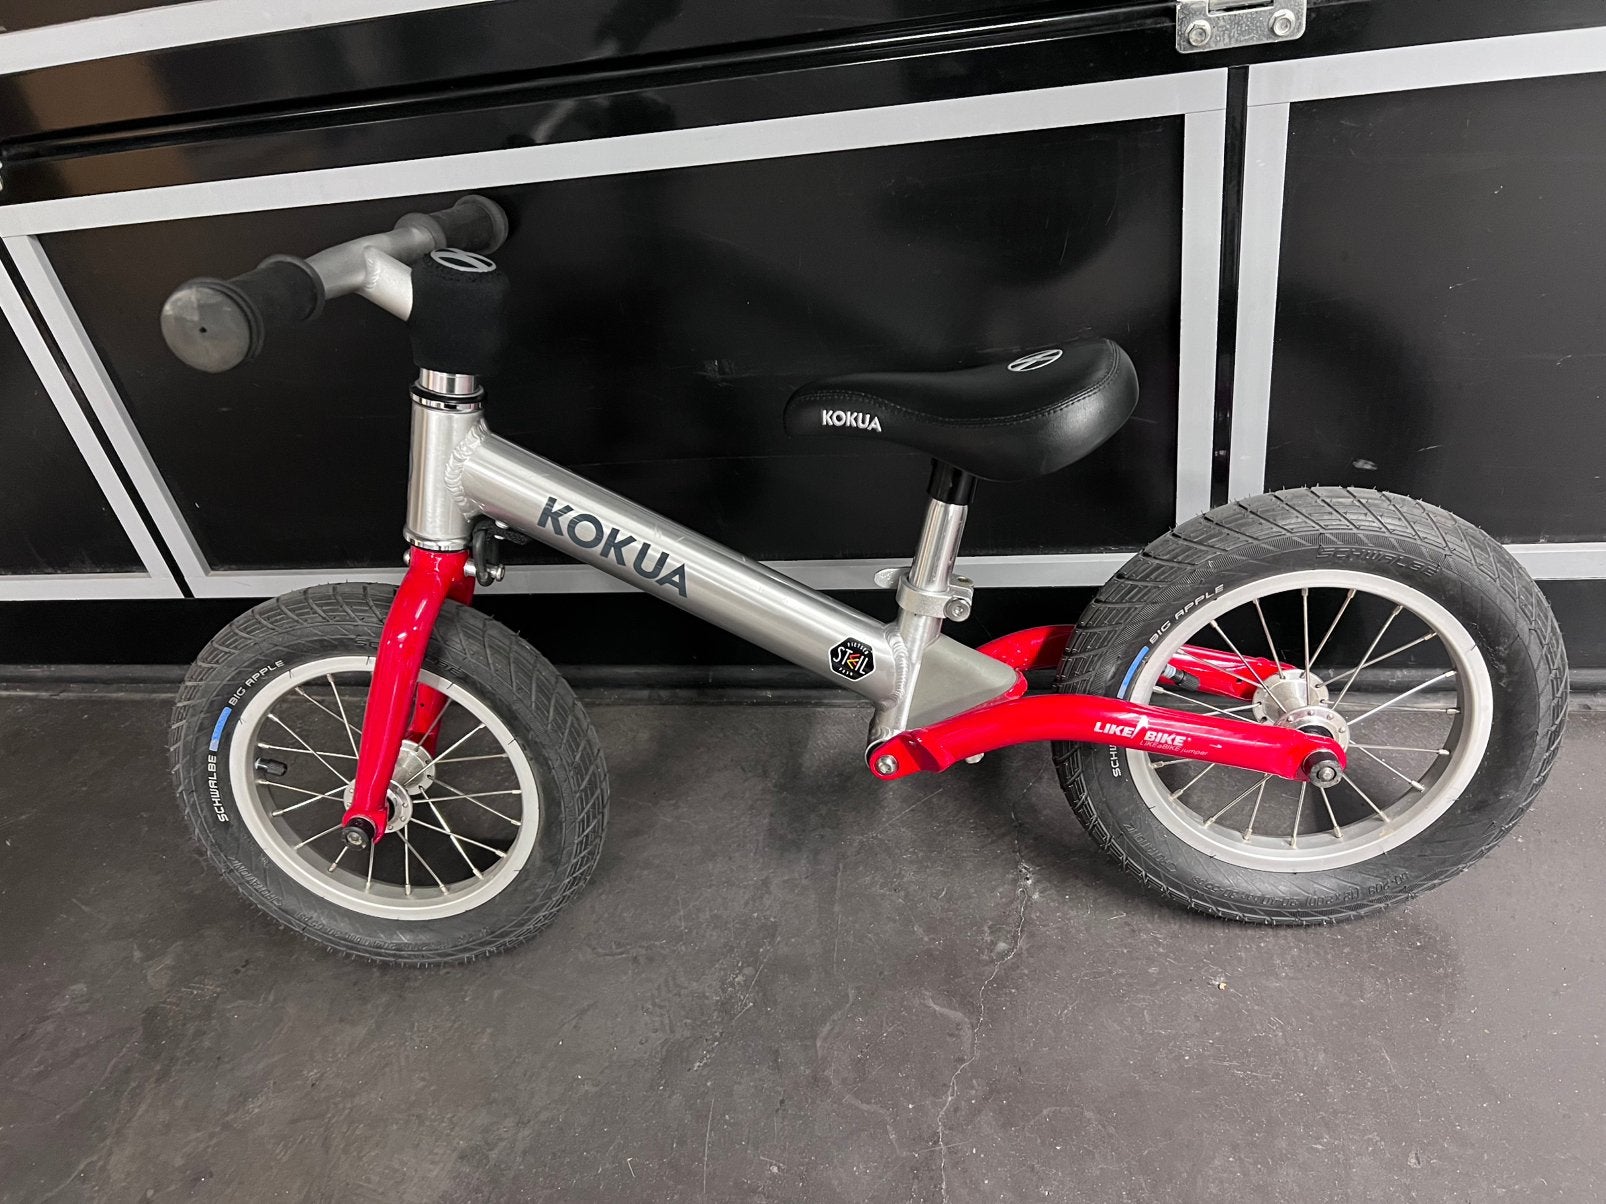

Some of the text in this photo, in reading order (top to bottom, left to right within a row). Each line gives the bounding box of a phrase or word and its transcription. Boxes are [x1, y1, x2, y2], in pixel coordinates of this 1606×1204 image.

[821, 409, 882, 432] KOKUA
[537, 496, 688, 598] KOKUA
[1149, 584, 1224, 644] BIG APPLE
[228, 660, 285, 706] BIG APPLE
[1093, 721, 1187, 747] LIKE BIKE
[207, 754, 229, 823] SCHWALBE
